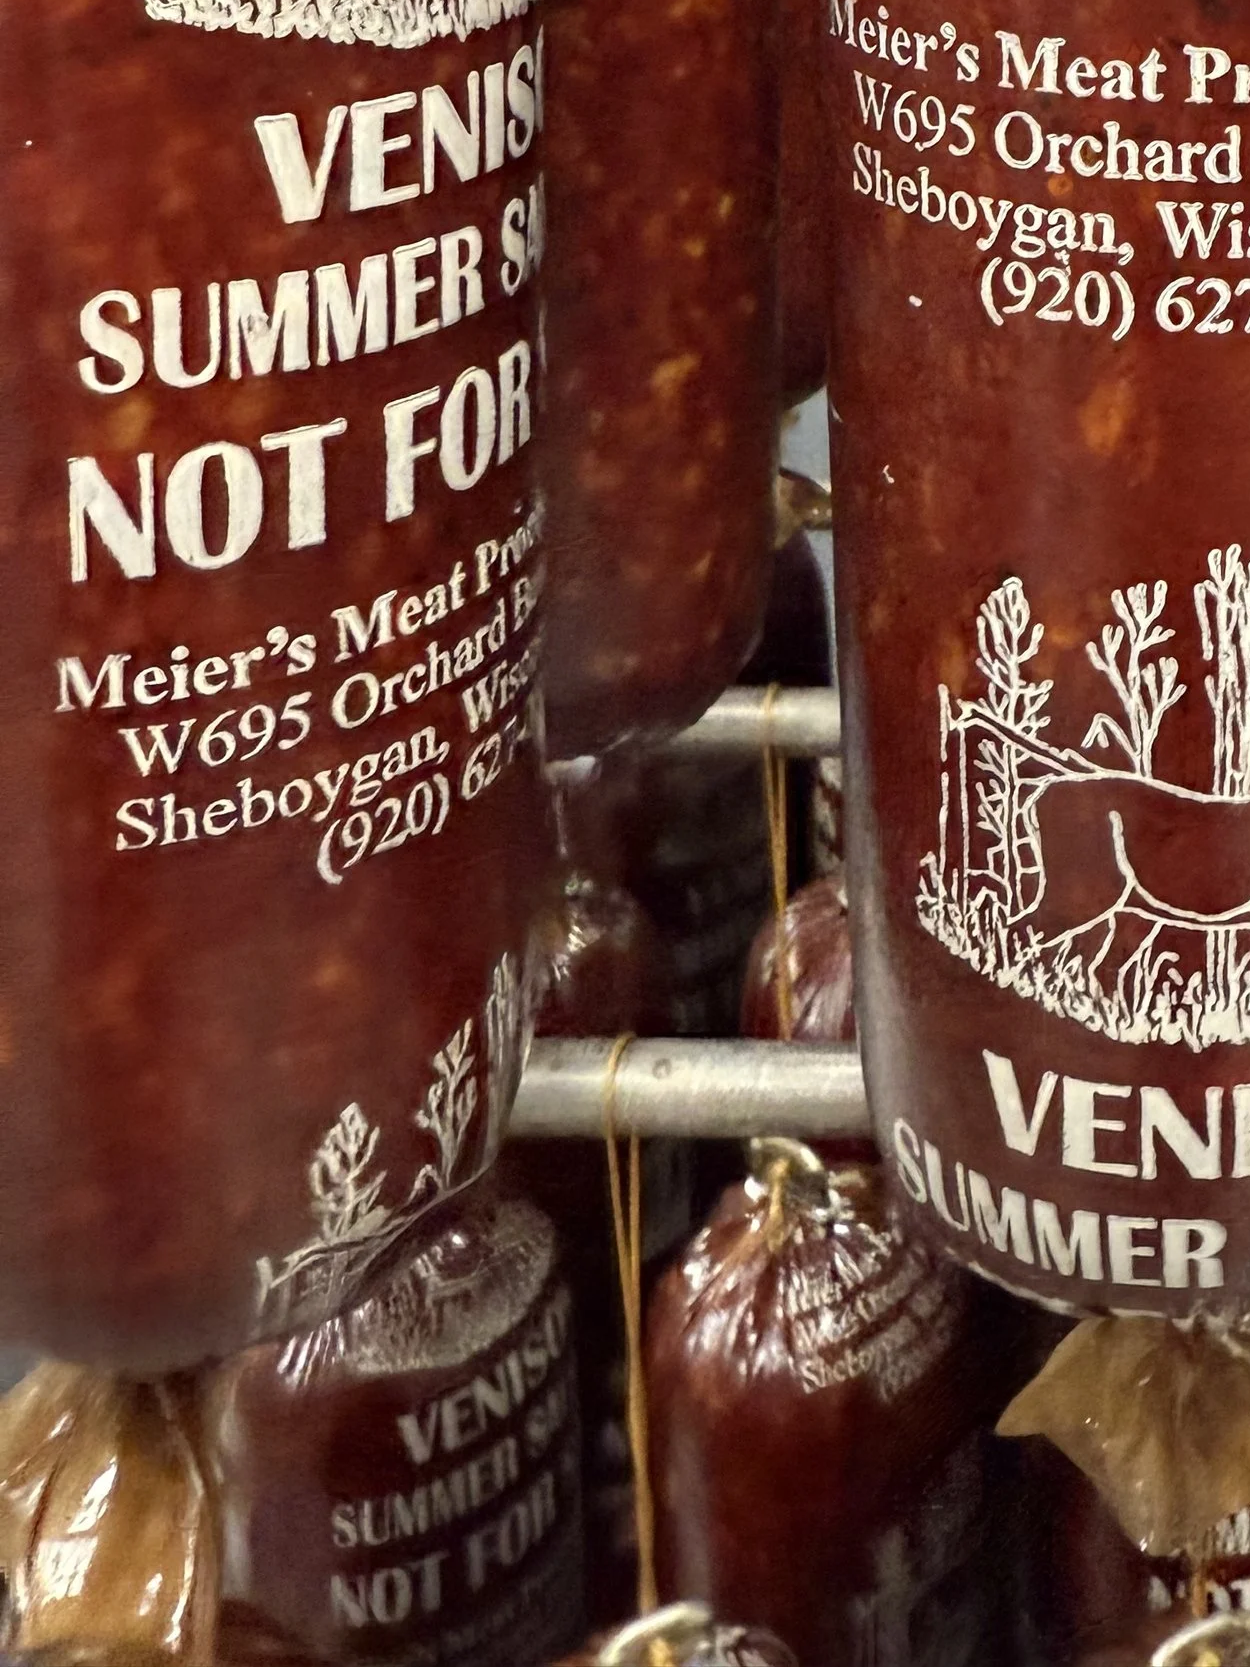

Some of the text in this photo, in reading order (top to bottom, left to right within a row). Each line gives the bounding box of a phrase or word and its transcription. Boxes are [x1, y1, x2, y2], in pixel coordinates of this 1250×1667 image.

[254, 24, 544, 224] VENIS
[852, 68, 977, 158] W695
[994, 110, 1243, 185] Orchard
[995, 30, 1167, 103] Meat
[851, 141, 1135, 267] Sheboygan,
[77, 225, 485, 395] SUMMER
[979, 256, 1137, 342] (920)
[67, 339, 532, 583] NOT FOR
[55, 625, 318, 714] Meier's
[330, 560, 466, 665] Meat
[117, 691, 312, 778] W695
[332, 597, 506, 729] Orchard
[115, 725, 451, 853] Sheboygan,
[316, 772, 451, 886] (920)
[891, 1117, 1228, 1289] SUMMER
[331, 1437, 519, 1549] SUMMER
[330, 1550, 450, 1628] NOT
